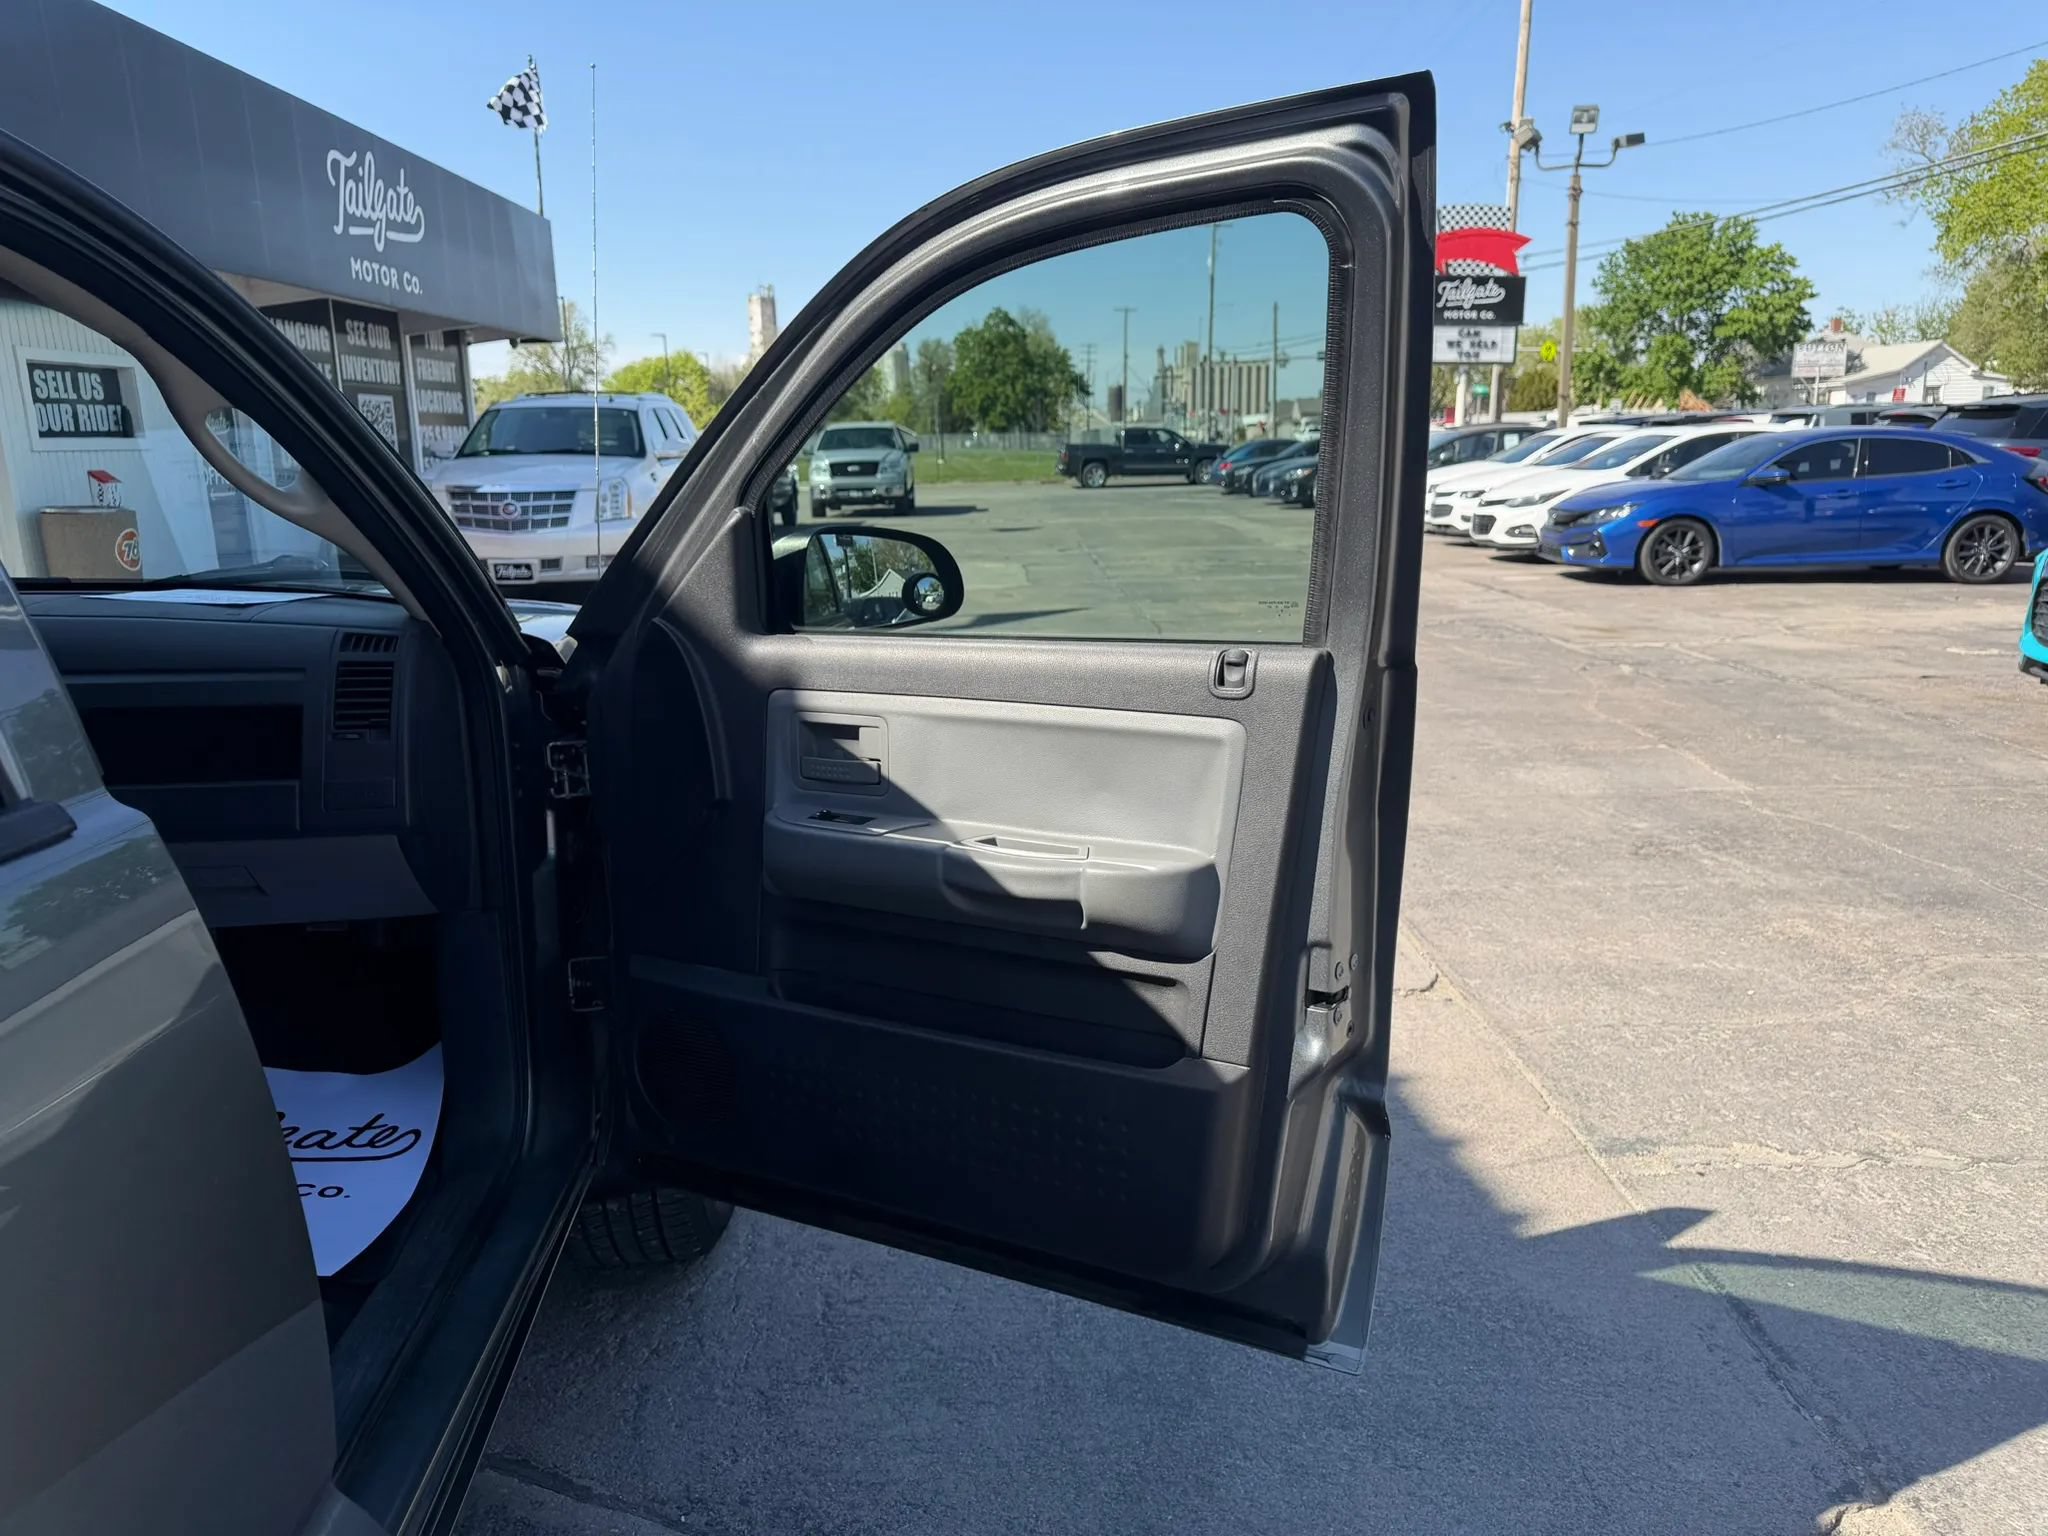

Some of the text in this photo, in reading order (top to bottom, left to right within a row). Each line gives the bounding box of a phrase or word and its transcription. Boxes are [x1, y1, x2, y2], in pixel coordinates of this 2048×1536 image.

[327, 149, 425, 252] Tailgate
[350, 256, 424, 295] MOTOR CO.
[1436, 277, 1506, 309] Tailgate
[1443, 309, 1497, 320] MOTOR CO.
[345, 318, 392, 350] SEE OUR
[33, 369, 105, 401] SELL US
[340, 354, 401, 385] INVENTORY
[416, 388, 464, 414] LOCATIONS
